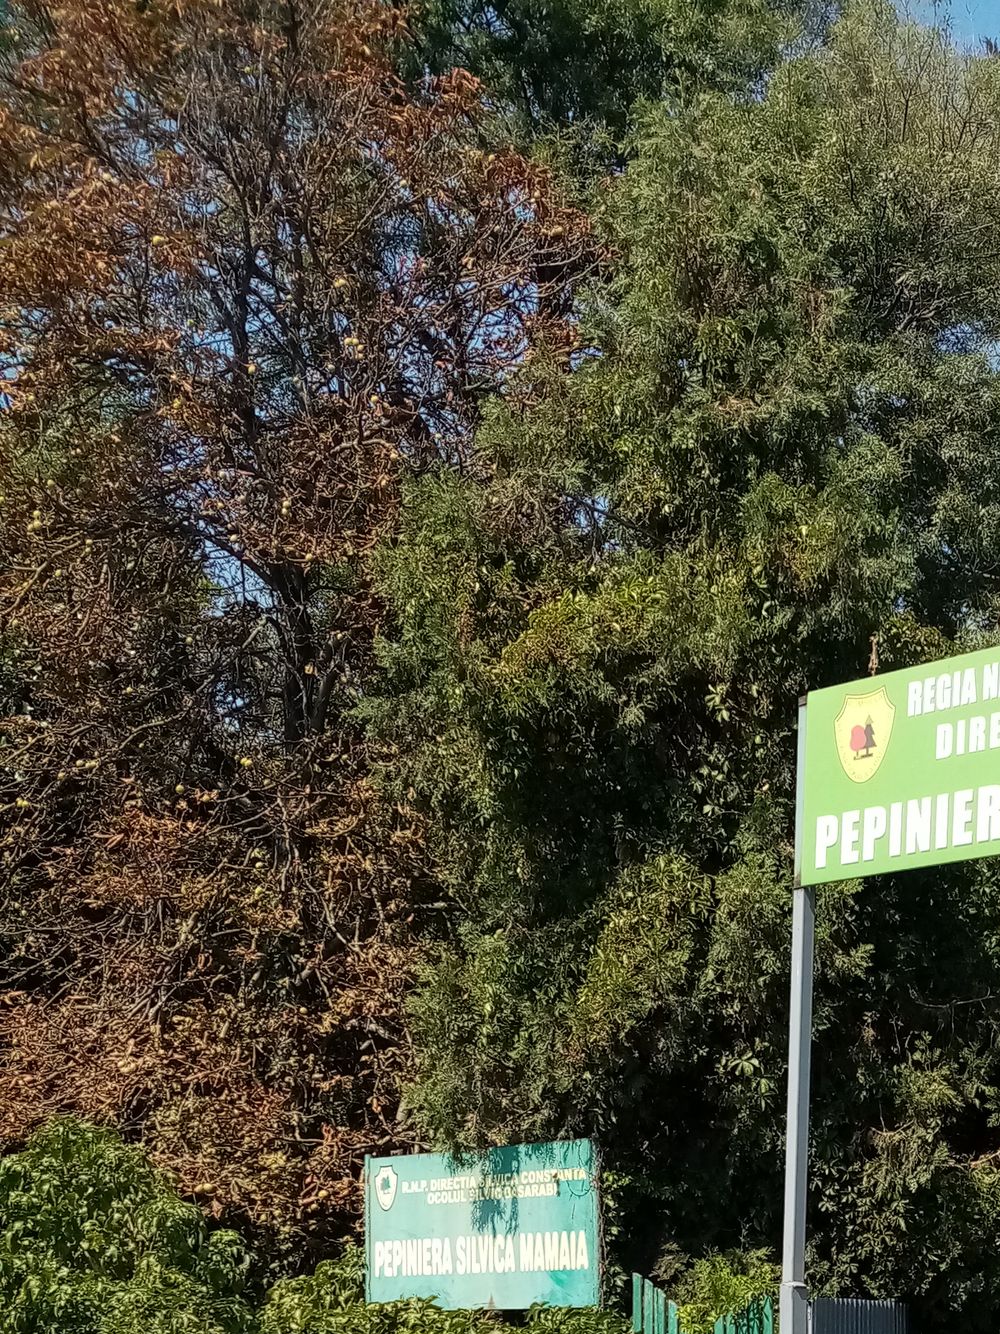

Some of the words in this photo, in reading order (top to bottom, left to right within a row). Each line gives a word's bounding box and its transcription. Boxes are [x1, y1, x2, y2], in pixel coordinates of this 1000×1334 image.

[907, 667, 977, 717] REGIA
[427, 1190, 467, 1205] OCOLUL
[430, 1176, 477, 1192] DIRECTIA
[374, 1237, 453, 1277] PEPINIERA
[455, 1234, 516, 1275] SILVICA
[519, 1230, 589, 1272] MAMAIA
